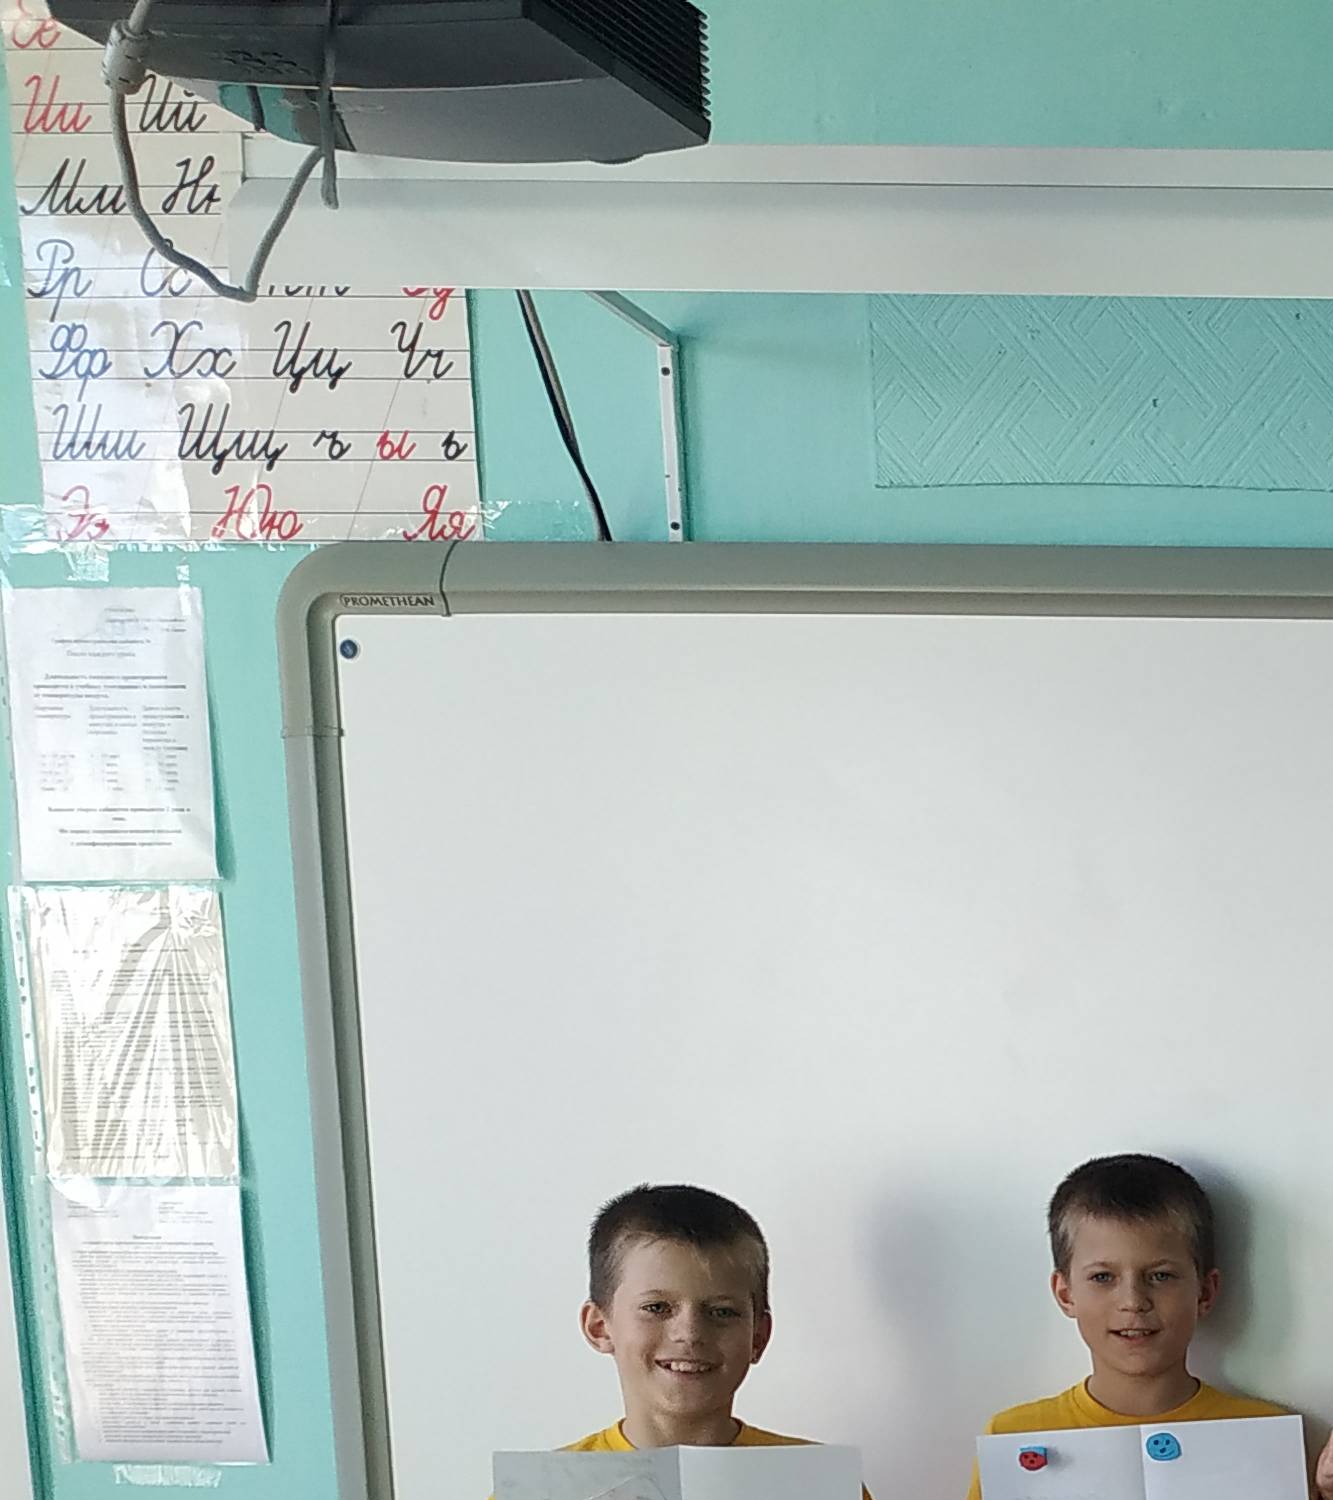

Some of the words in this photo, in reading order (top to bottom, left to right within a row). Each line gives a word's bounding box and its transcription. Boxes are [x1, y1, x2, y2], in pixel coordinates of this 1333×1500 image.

[25, 74, 93, 133] Ии
[20, 158, 127, 214] Мм
[27, 238, 93, 323] Рр
[38, 322, 113, 402] Фф
[143, 320, 237, 380] Хх
[272, 320, 353, 394] Цц
[390, 321, 454, 379] Чч
[52, 403, 146, 460] Шш
[177, 402, 288, 476] Щщ
[312, 429, 352, 461] ъ
[376, 429, 416, 461] ы
[441, 429, 468, 461] ь
[343, 595, 436, 608] PROMETHEAN
